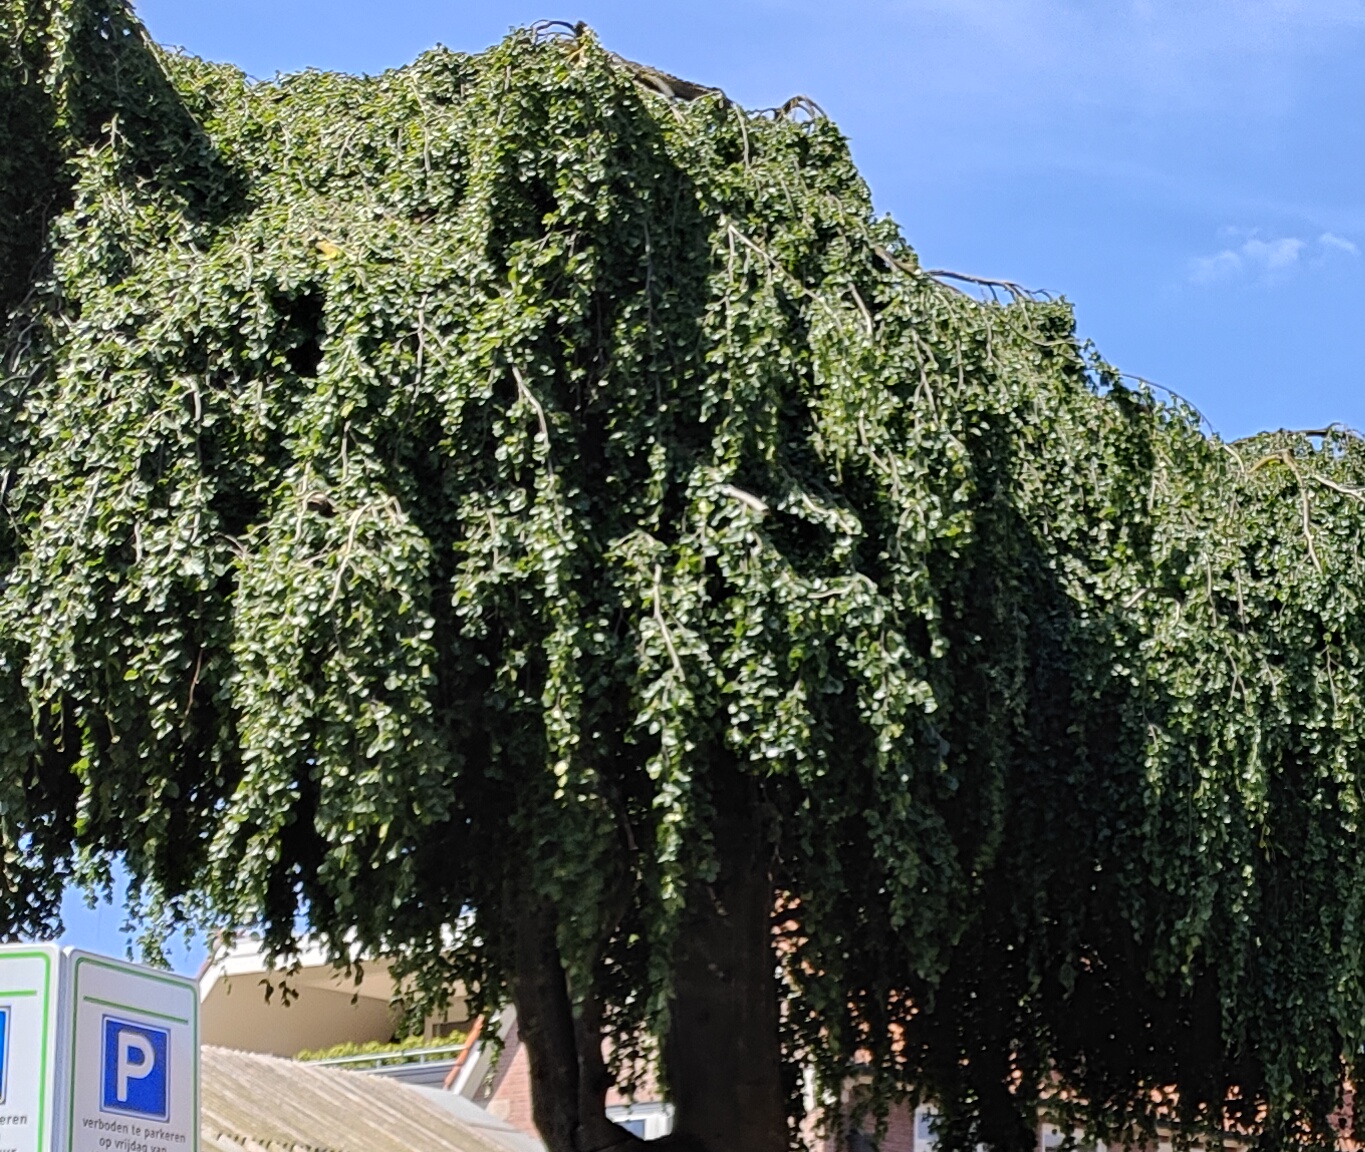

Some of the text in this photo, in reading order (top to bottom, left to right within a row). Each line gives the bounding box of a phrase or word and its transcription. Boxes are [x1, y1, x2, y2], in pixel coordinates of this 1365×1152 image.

[82, 1117, 186, 1143] verboden te parkeren
[99, 1137, 112, 1149] op
